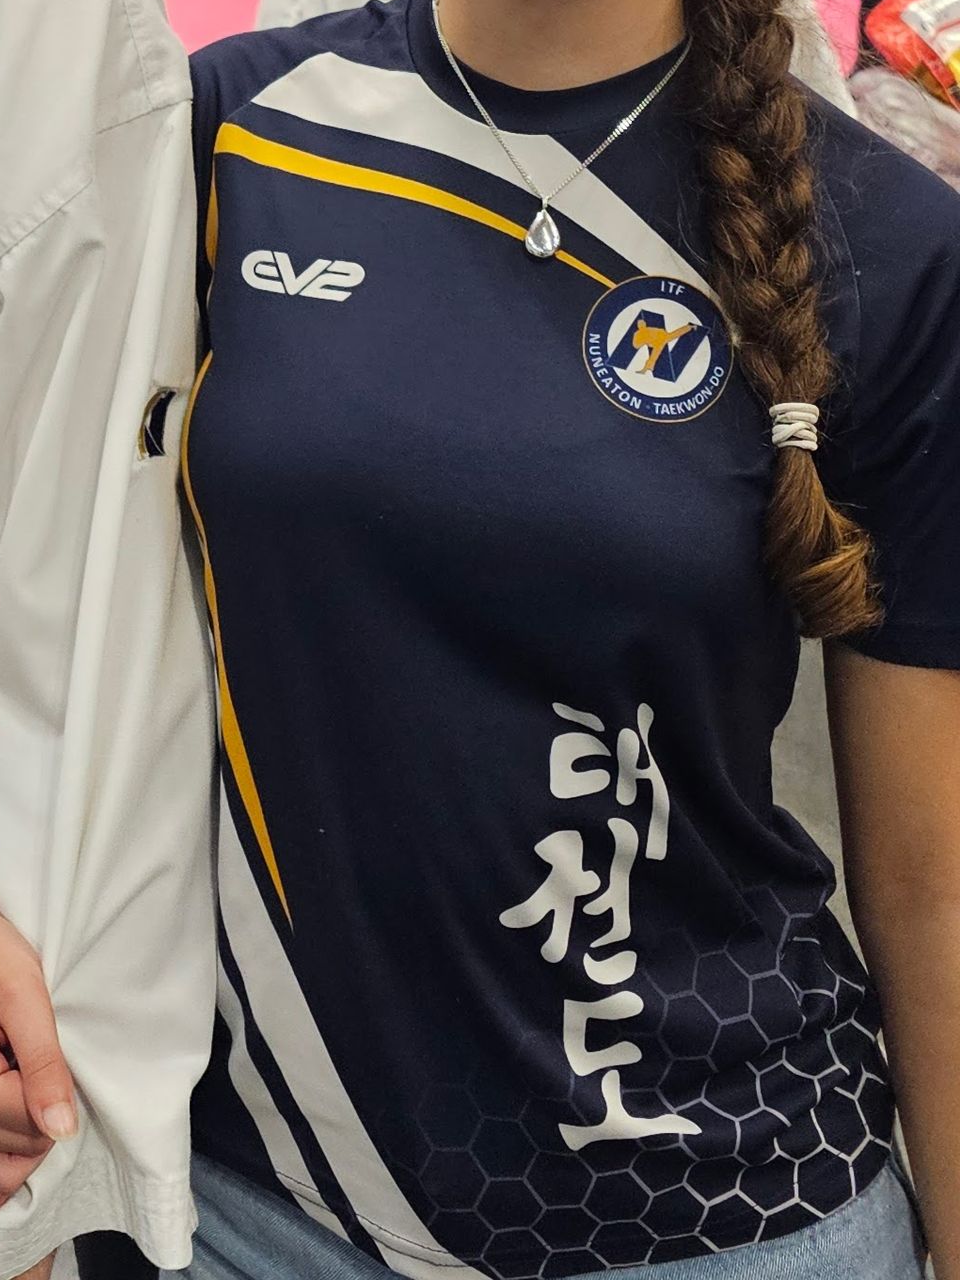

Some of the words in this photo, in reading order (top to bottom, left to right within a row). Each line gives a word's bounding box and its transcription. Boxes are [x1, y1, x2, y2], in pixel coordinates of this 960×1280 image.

[660, 280, 686, 296] ITF
[589, 333, 642, 410] NUNEATON
[653, 366, 725, 415] TAEKWON-DO
[499, 702, 702, 1151] 태권도
